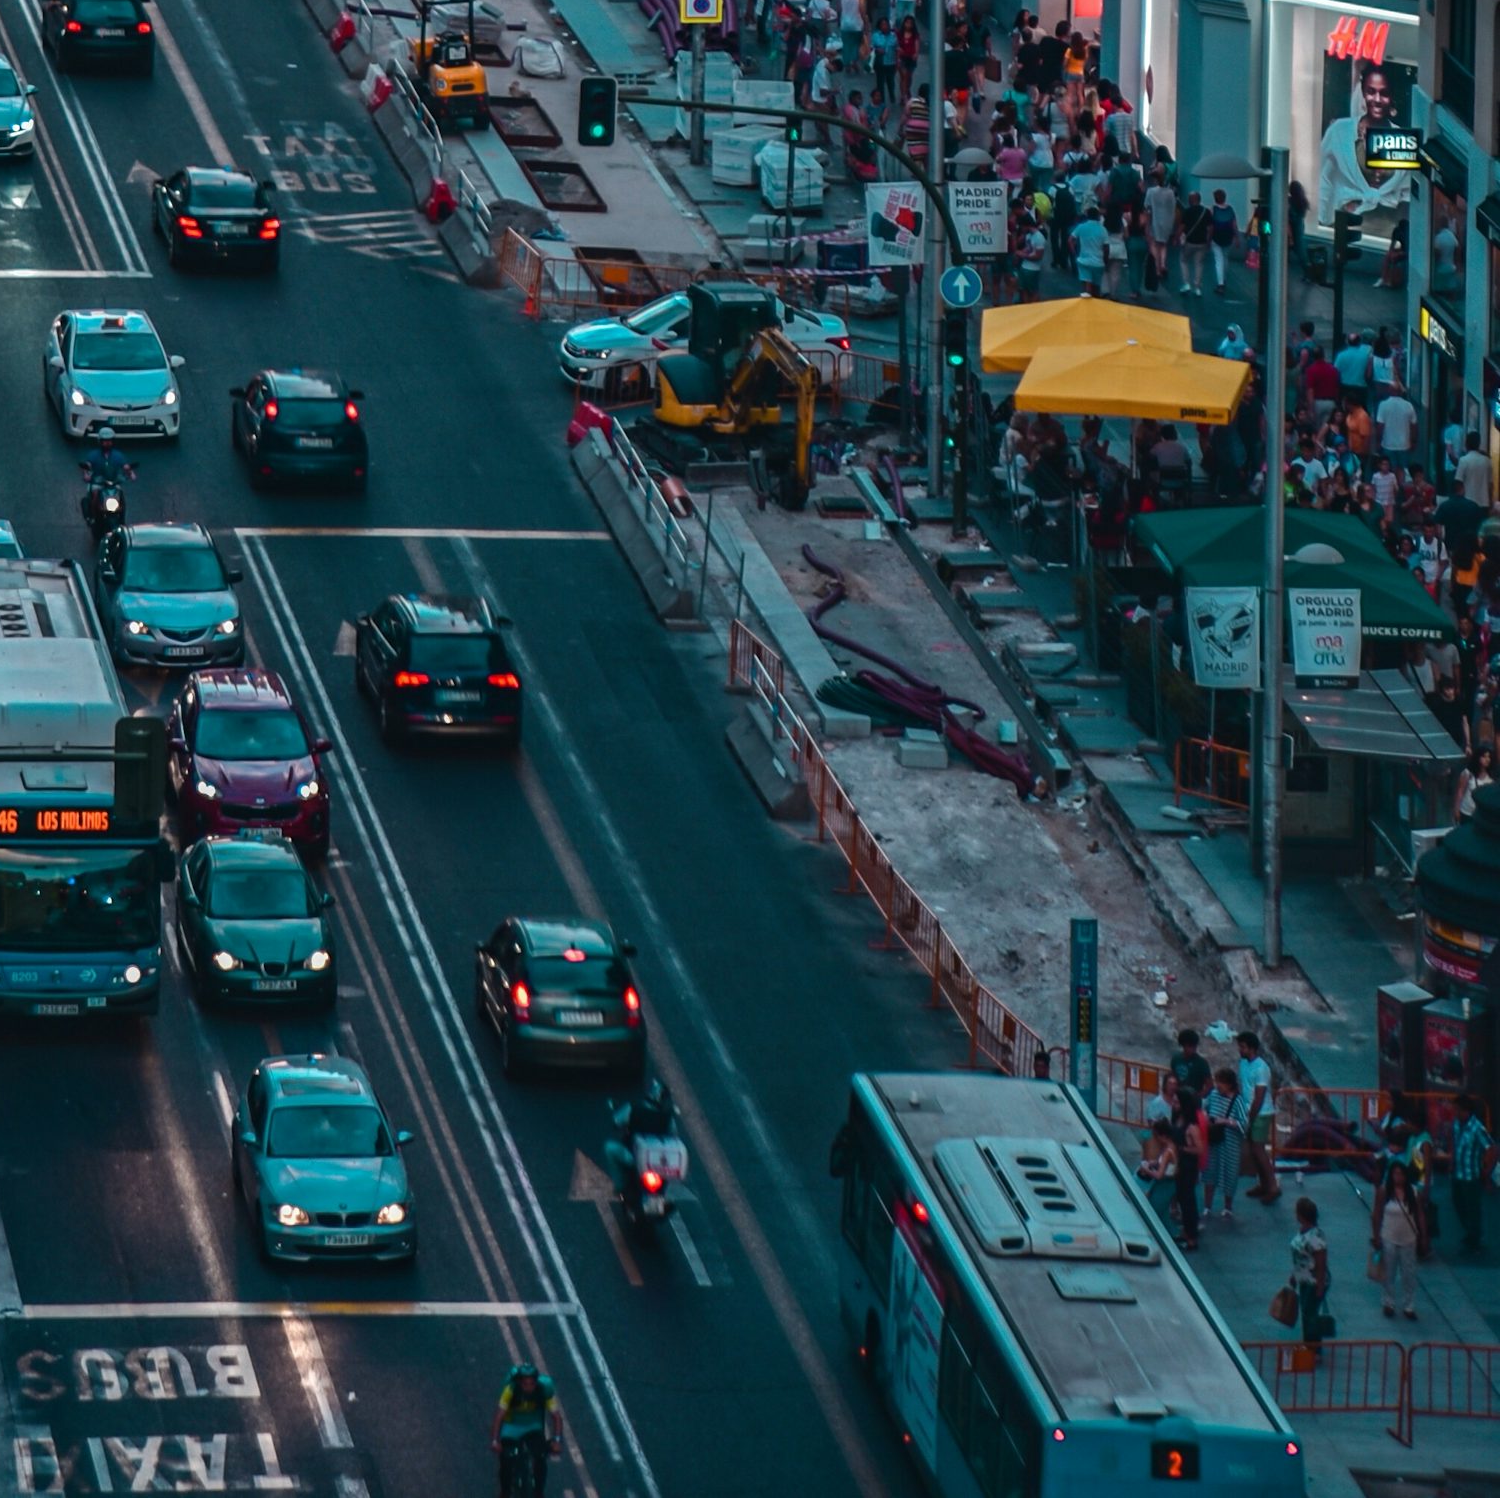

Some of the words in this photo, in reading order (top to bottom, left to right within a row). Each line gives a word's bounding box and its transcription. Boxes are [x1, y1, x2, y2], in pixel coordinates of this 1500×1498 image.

[1327, 15, 1390, 66] H&M
[1372, 133, 1418, 153] pans
[271, 169, 377, 193] BUS
[955, 187, 1003, 198] MADRID
[955, 198, 992, 209] PRIDE
[1181, 407, 1208, 419] pans
[1295, 596, 1354, 606] ORGULLO
[1306, 607, 1354, 618] MADRID
[1362, 626, 1399, 636] BUCKS
[1400, 626, 1443, 639] COFFEE
[1204, 662, 1249, 672] MADRID
[36, 810, 59, 831] LOS
[60, 810, 109, 832] MOLINOS
[11, 971, 38, 982] 8203
[1168, 1450, 1183, 1478] 2
